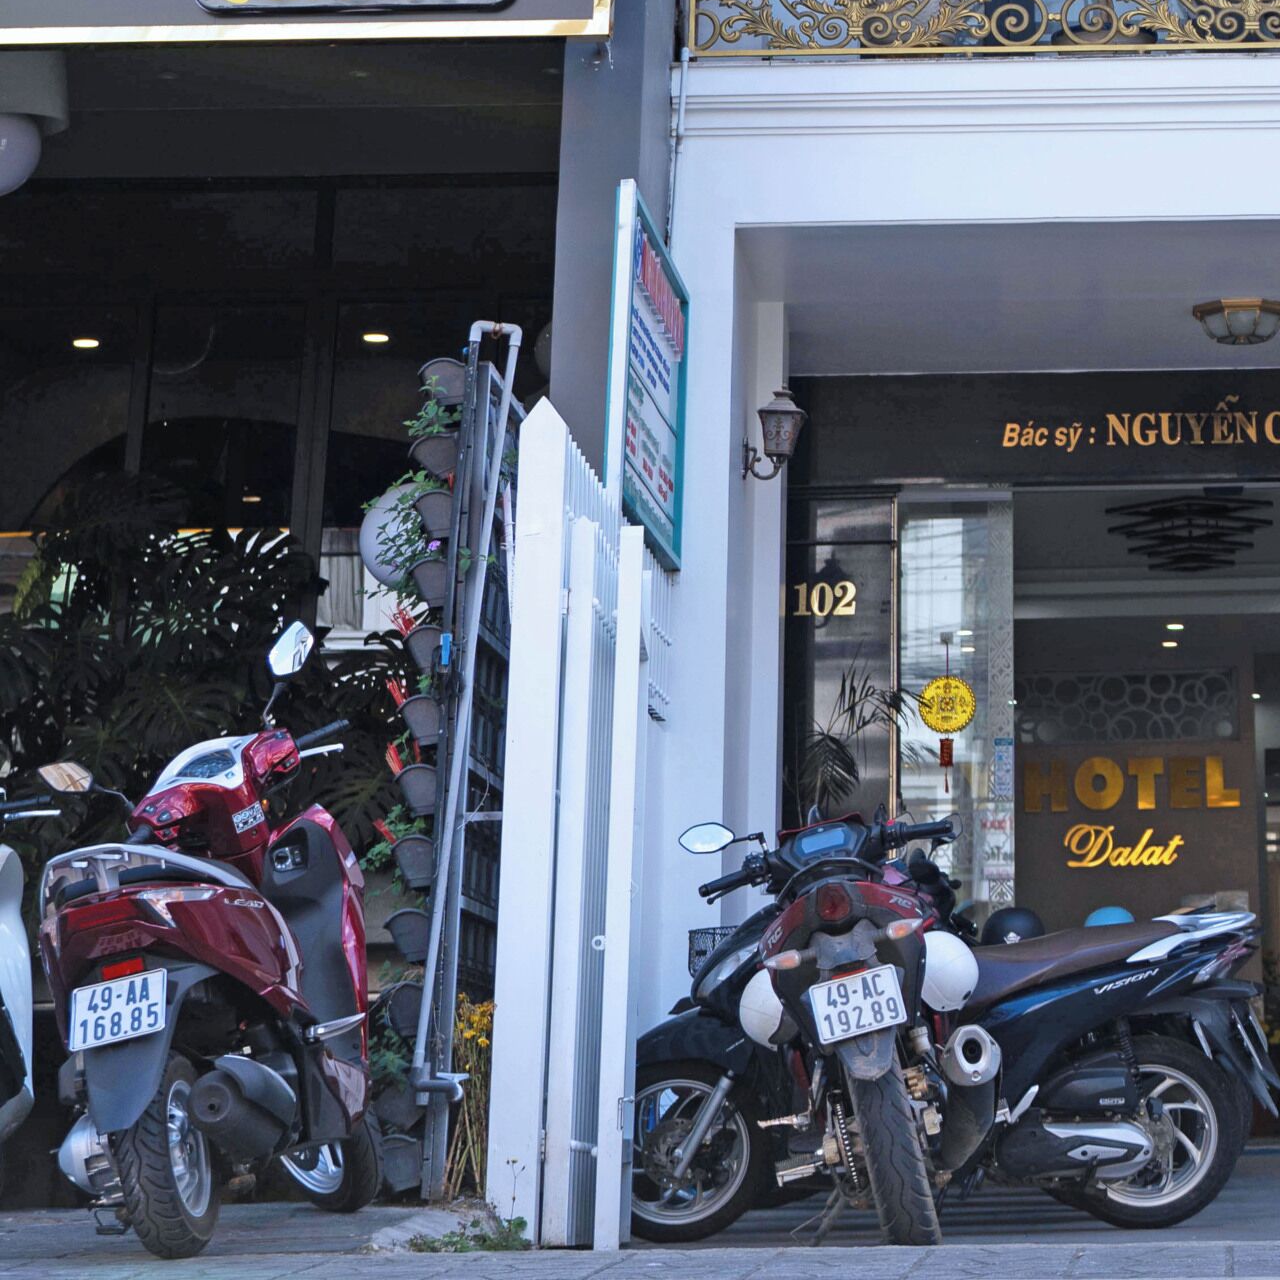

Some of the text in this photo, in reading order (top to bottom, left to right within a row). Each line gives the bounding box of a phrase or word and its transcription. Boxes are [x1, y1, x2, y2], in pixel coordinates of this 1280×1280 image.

[1002, 417, 1048, 448] Bác
[1105, 394, 1259, 447] NGUYỄN
[792, 580, 858, 617] 102
[1024, 755, 1242, 813] HOTEL
[1064, 823, 1185, 868] Dalat
[224, 898, 265, 909] LEAD
[87, 976, 151, 1015] 49-AA
[826, 973, 886, 1009] 49-AC
[1093, 967, 1160, 995] VISION
[79, 1002, 160, 1044] 168.85
[823, 997, 900, 1037] 192.89
